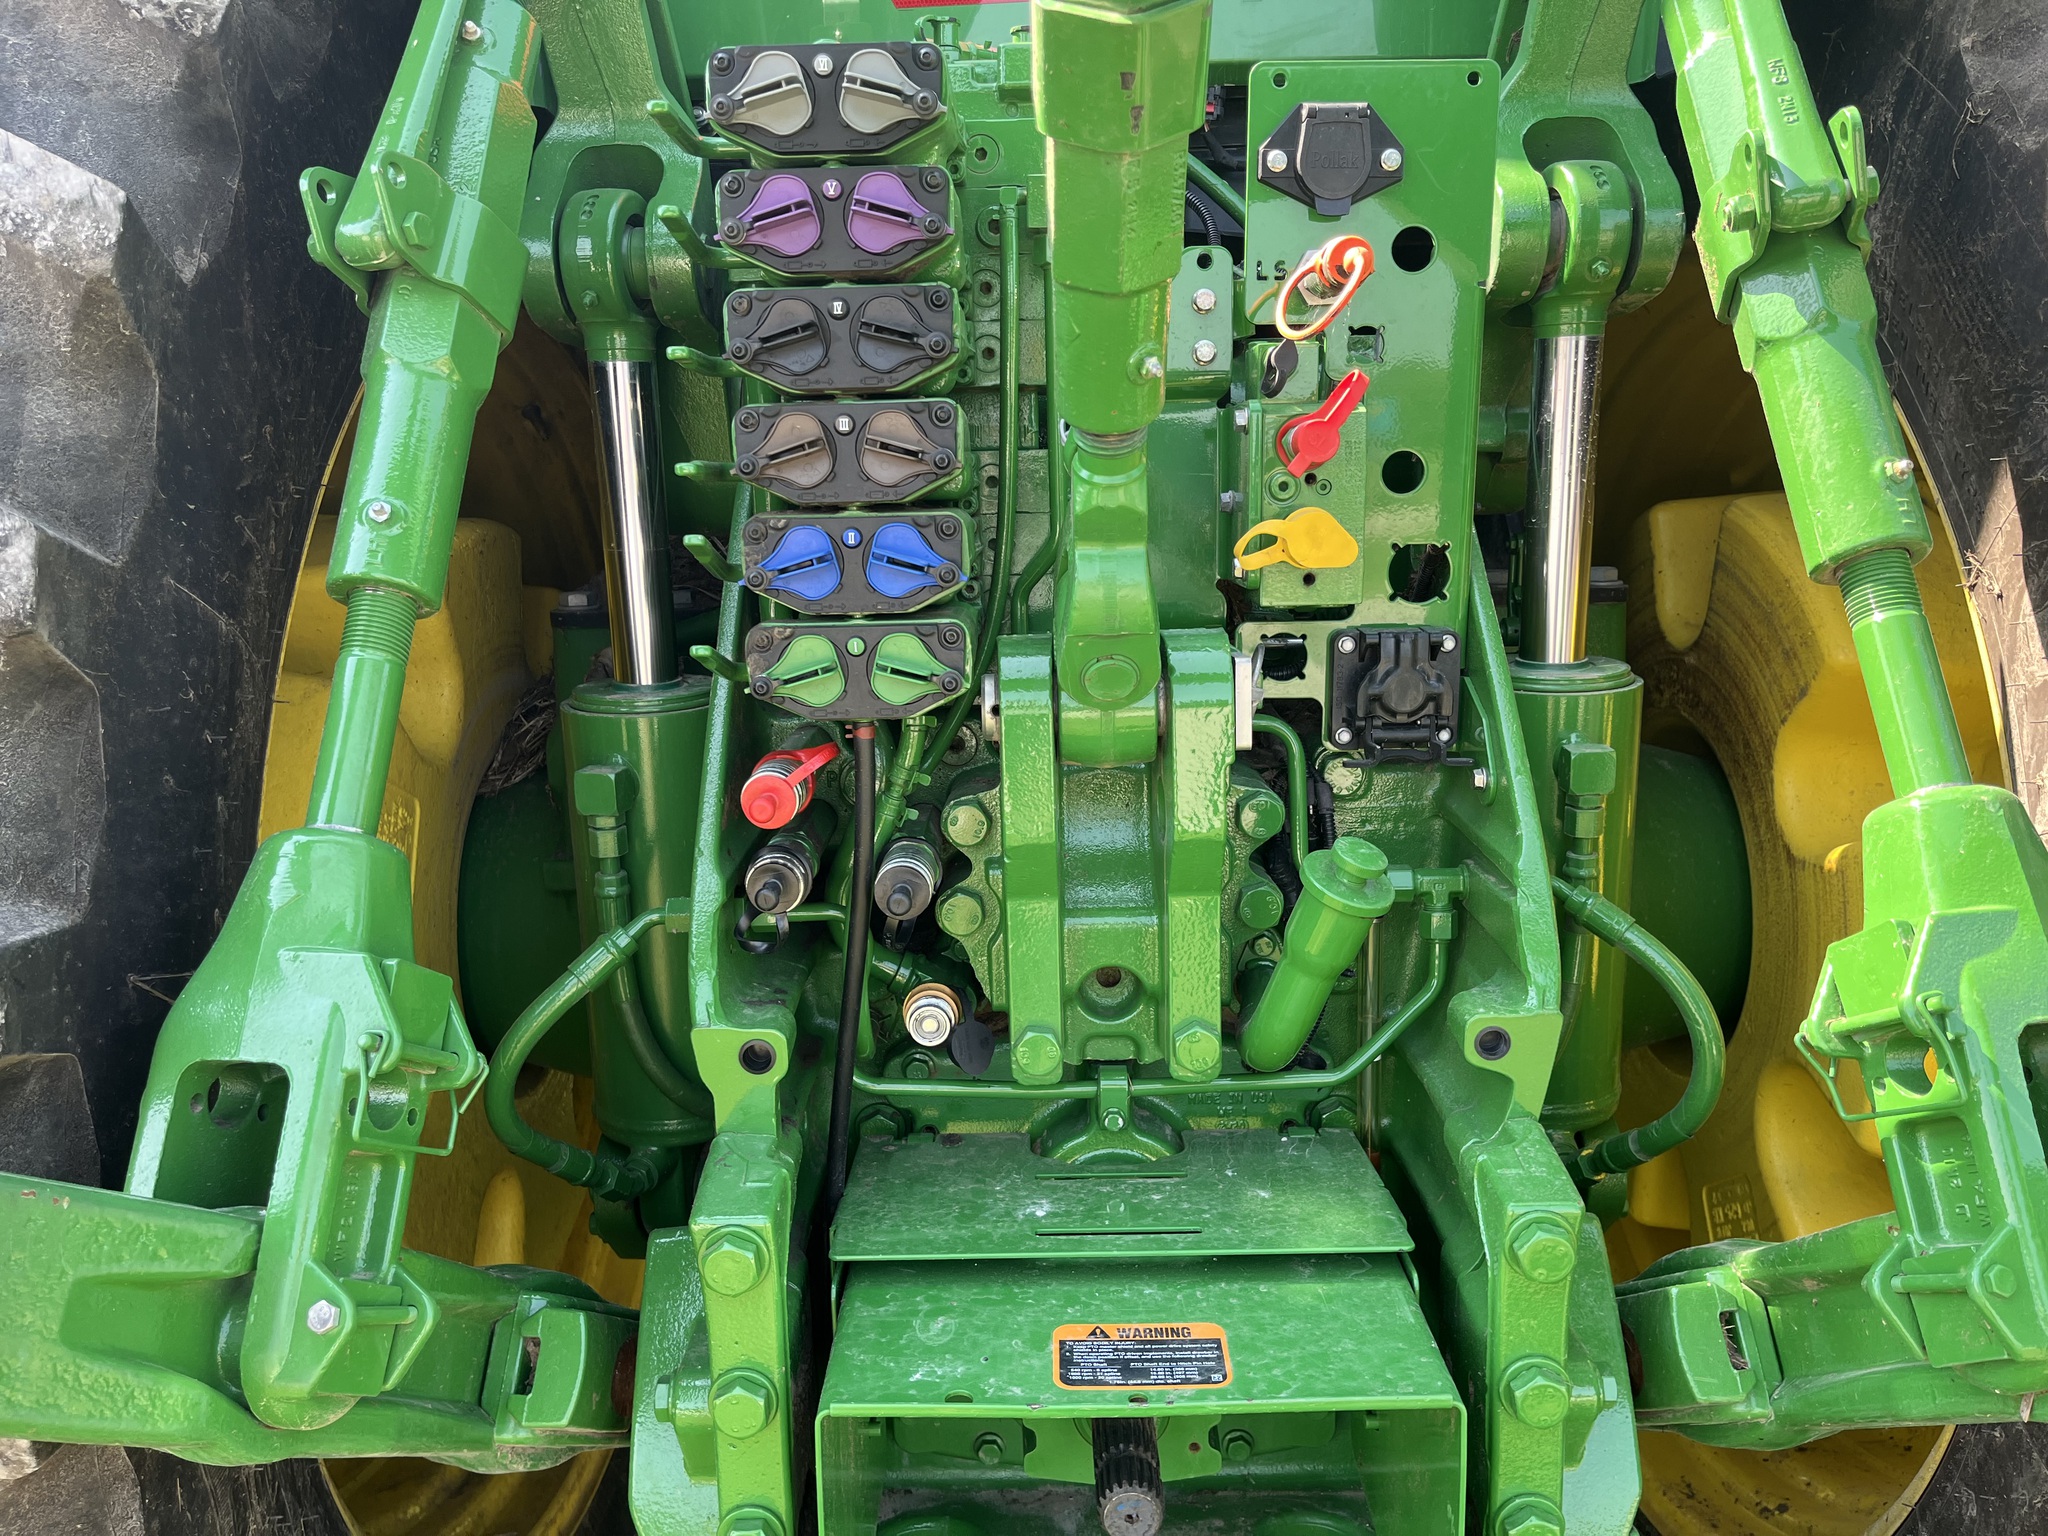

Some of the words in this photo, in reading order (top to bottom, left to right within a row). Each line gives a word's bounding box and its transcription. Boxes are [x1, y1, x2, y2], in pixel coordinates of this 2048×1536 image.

[818, 58, 829, 71] VI
[1311, 151, 1359, 169] Pollak
[826, 182, 837, 195] V
[1256, 259, 1288, 281] LS
[832, 302, 843, 315] IV
[848, 532, 855, 544] II
[826, 770, 838, 788] P
[1116, 1326, 1191, 1339] WARNING
